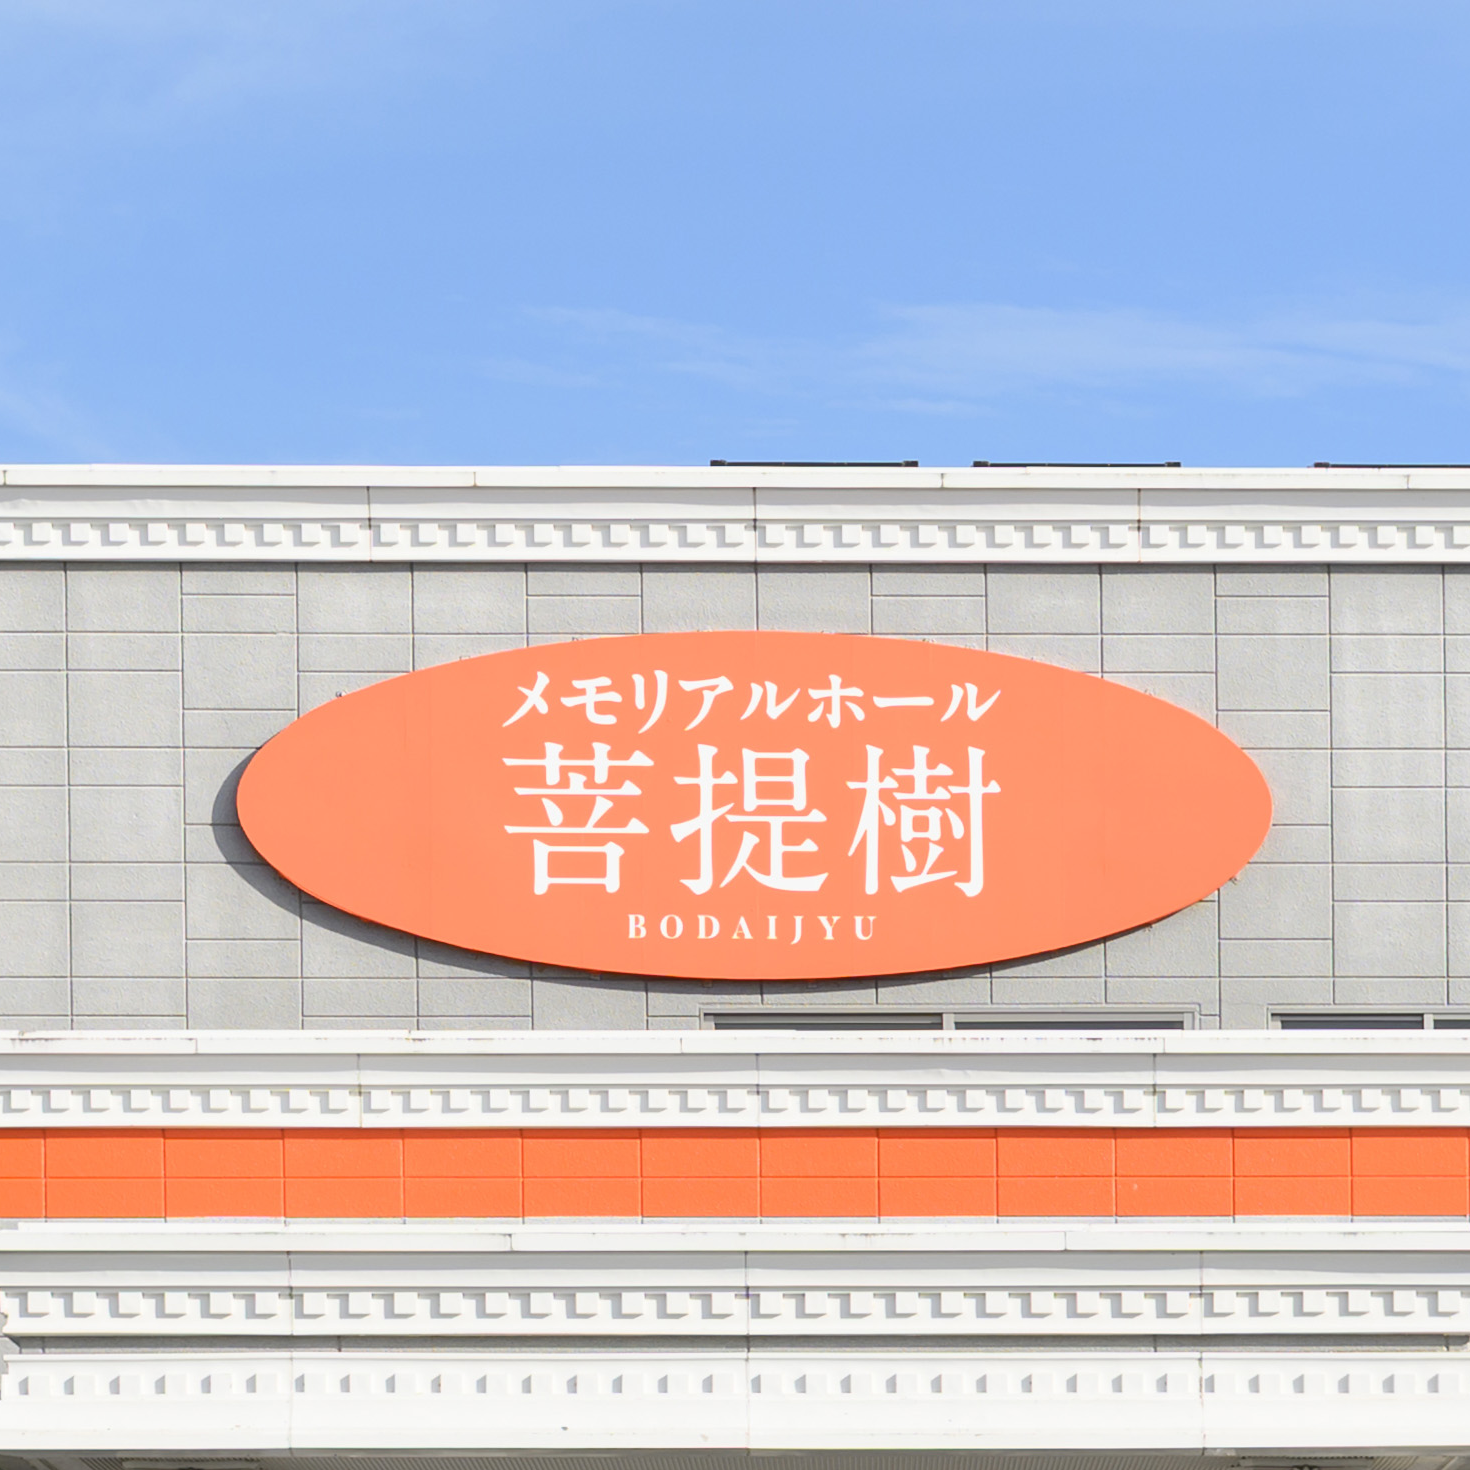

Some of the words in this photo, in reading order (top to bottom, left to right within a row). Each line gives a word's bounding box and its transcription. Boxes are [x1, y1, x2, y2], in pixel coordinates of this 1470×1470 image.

[501, 669, 1002, 734] メモリアルホール
[501, 741, 1003, 898] 菩提樹
[627, 914, 877, 944] BODAIJYU
